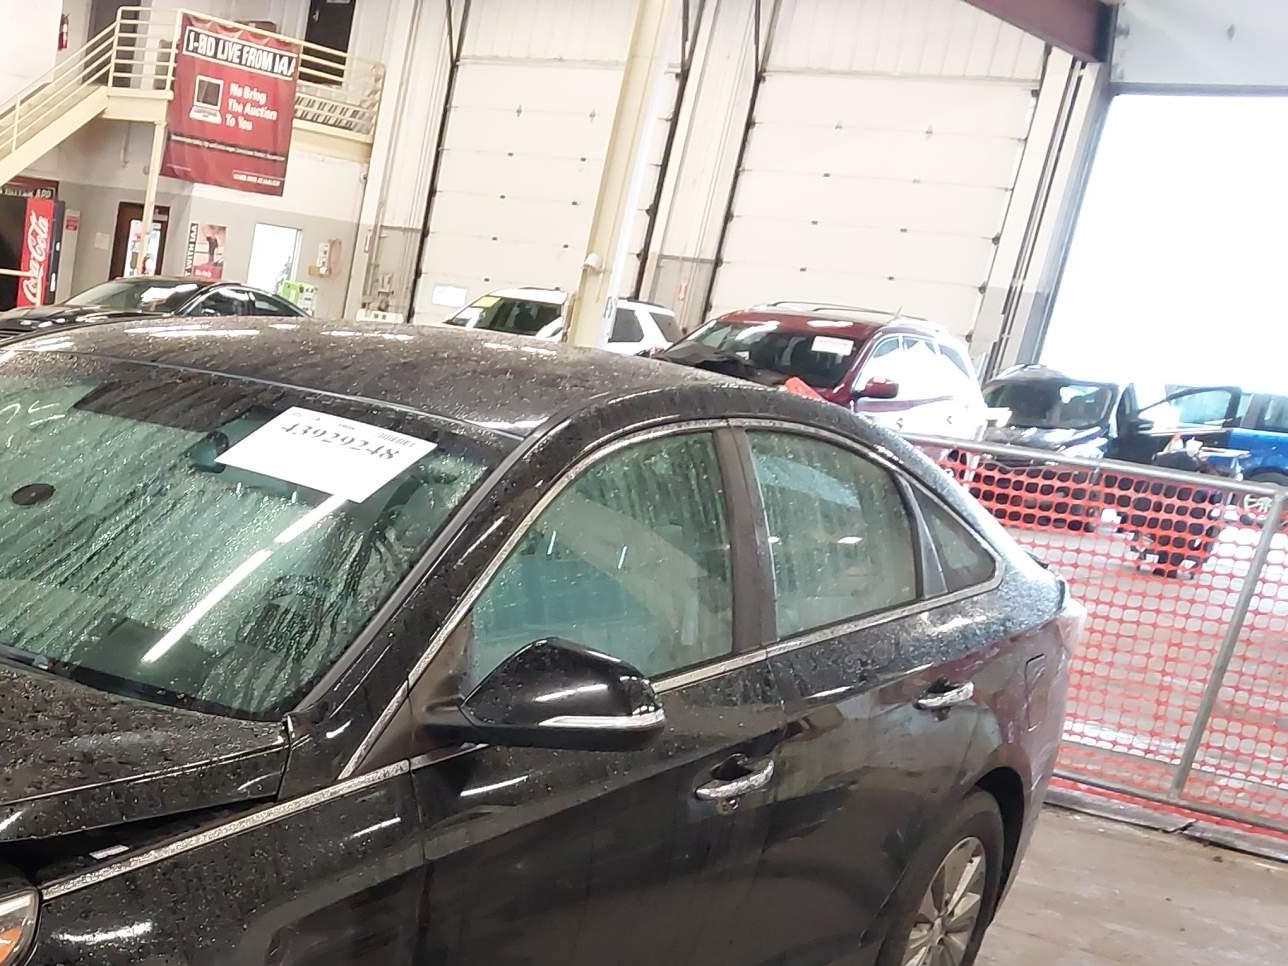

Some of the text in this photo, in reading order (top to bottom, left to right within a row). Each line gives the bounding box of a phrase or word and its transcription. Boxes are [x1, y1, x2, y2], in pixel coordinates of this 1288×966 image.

[216, 40, 241, 63] LIVE
[241, 45, 275, 72] FROM
[243, 86, 267, 105] Bring
[228, 98, 278, 120] The Auction
[225, 113, 253, 131] To You
[281, 423, 400, 460] 43929248
